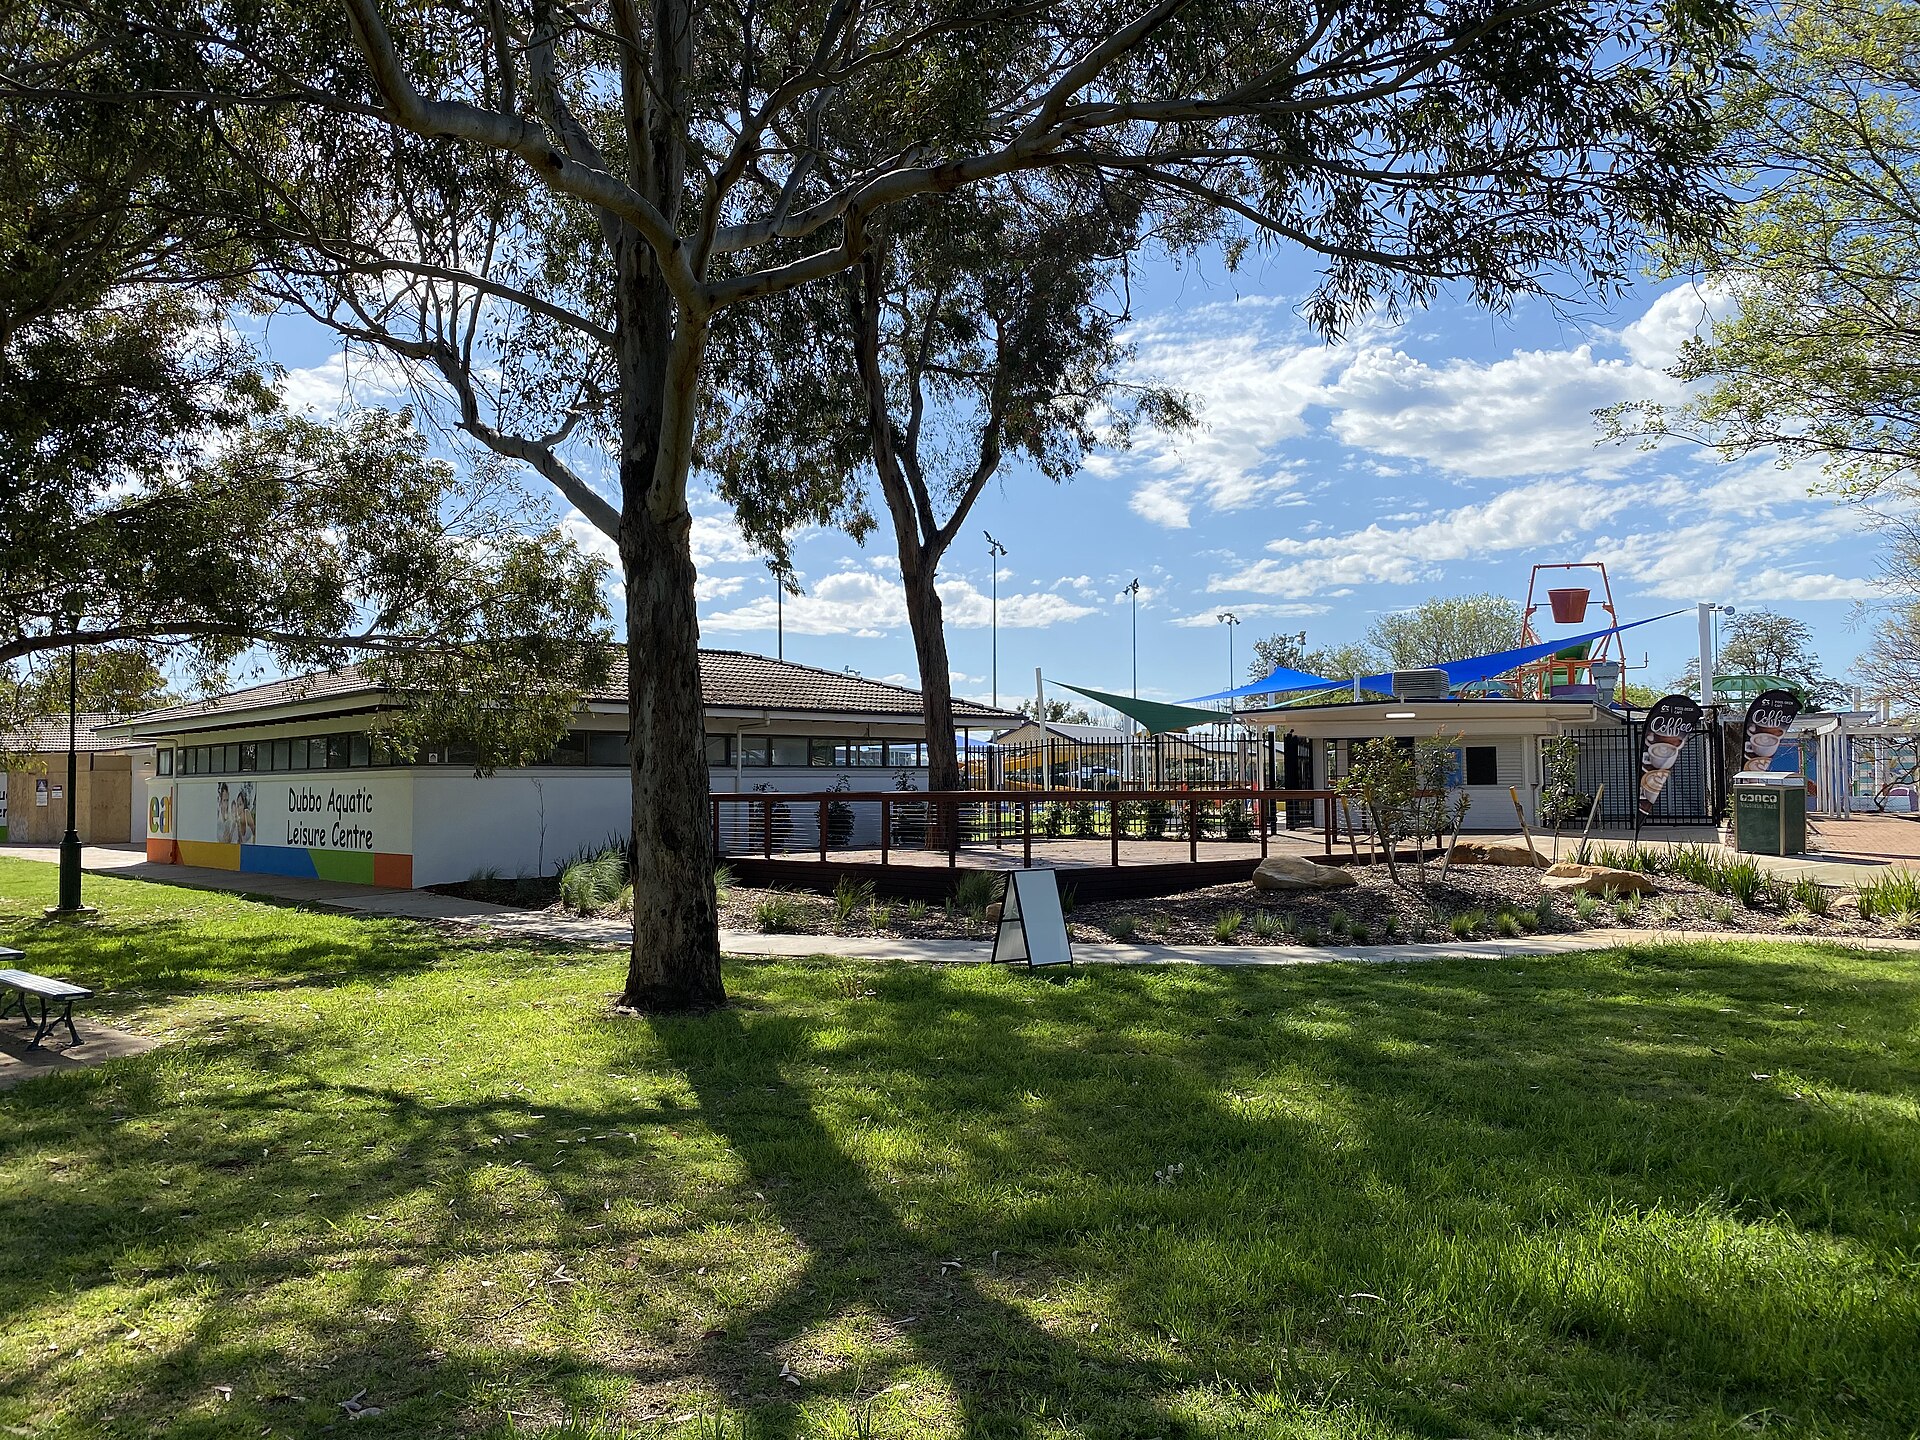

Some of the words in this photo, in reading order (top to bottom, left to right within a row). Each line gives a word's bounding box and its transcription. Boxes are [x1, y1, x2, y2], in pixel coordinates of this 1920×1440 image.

[1651, 716, 1692, 737] Coffee
[1752, 709, 1792, 727] Coffee
[288, 787, 322, 812] Dubbo
[327, 787, 373, 820] Aquatic
[287, 820, 326, 847] Leisure
[331, 822, 373, 850] Centre
